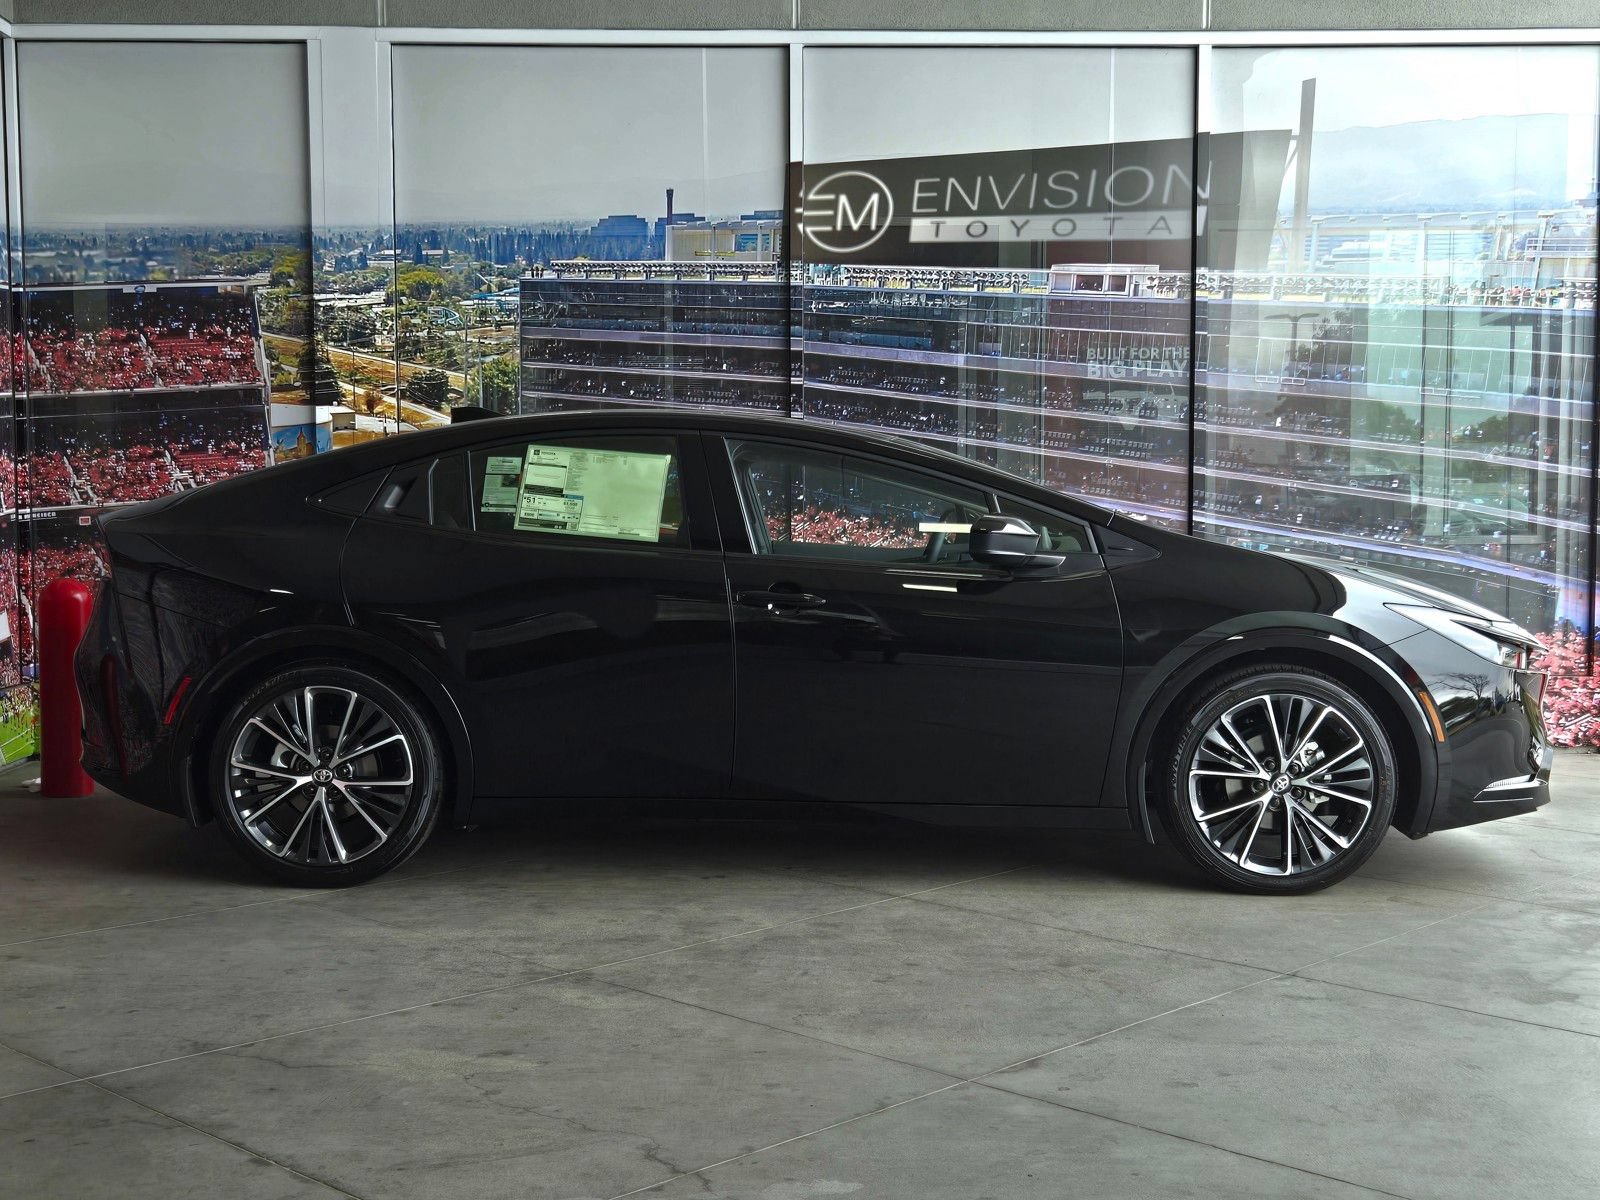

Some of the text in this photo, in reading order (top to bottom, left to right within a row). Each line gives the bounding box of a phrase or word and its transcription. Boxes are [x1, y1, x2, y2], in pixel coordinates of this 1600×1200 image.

[912, 160, 1211, 213] ENVISION
[930, 215, 1173, 239] TOYOTA
[1087, 346, 1190, 360] BUILT FOR THE
[1087, 360, 1126, 378] BIG
